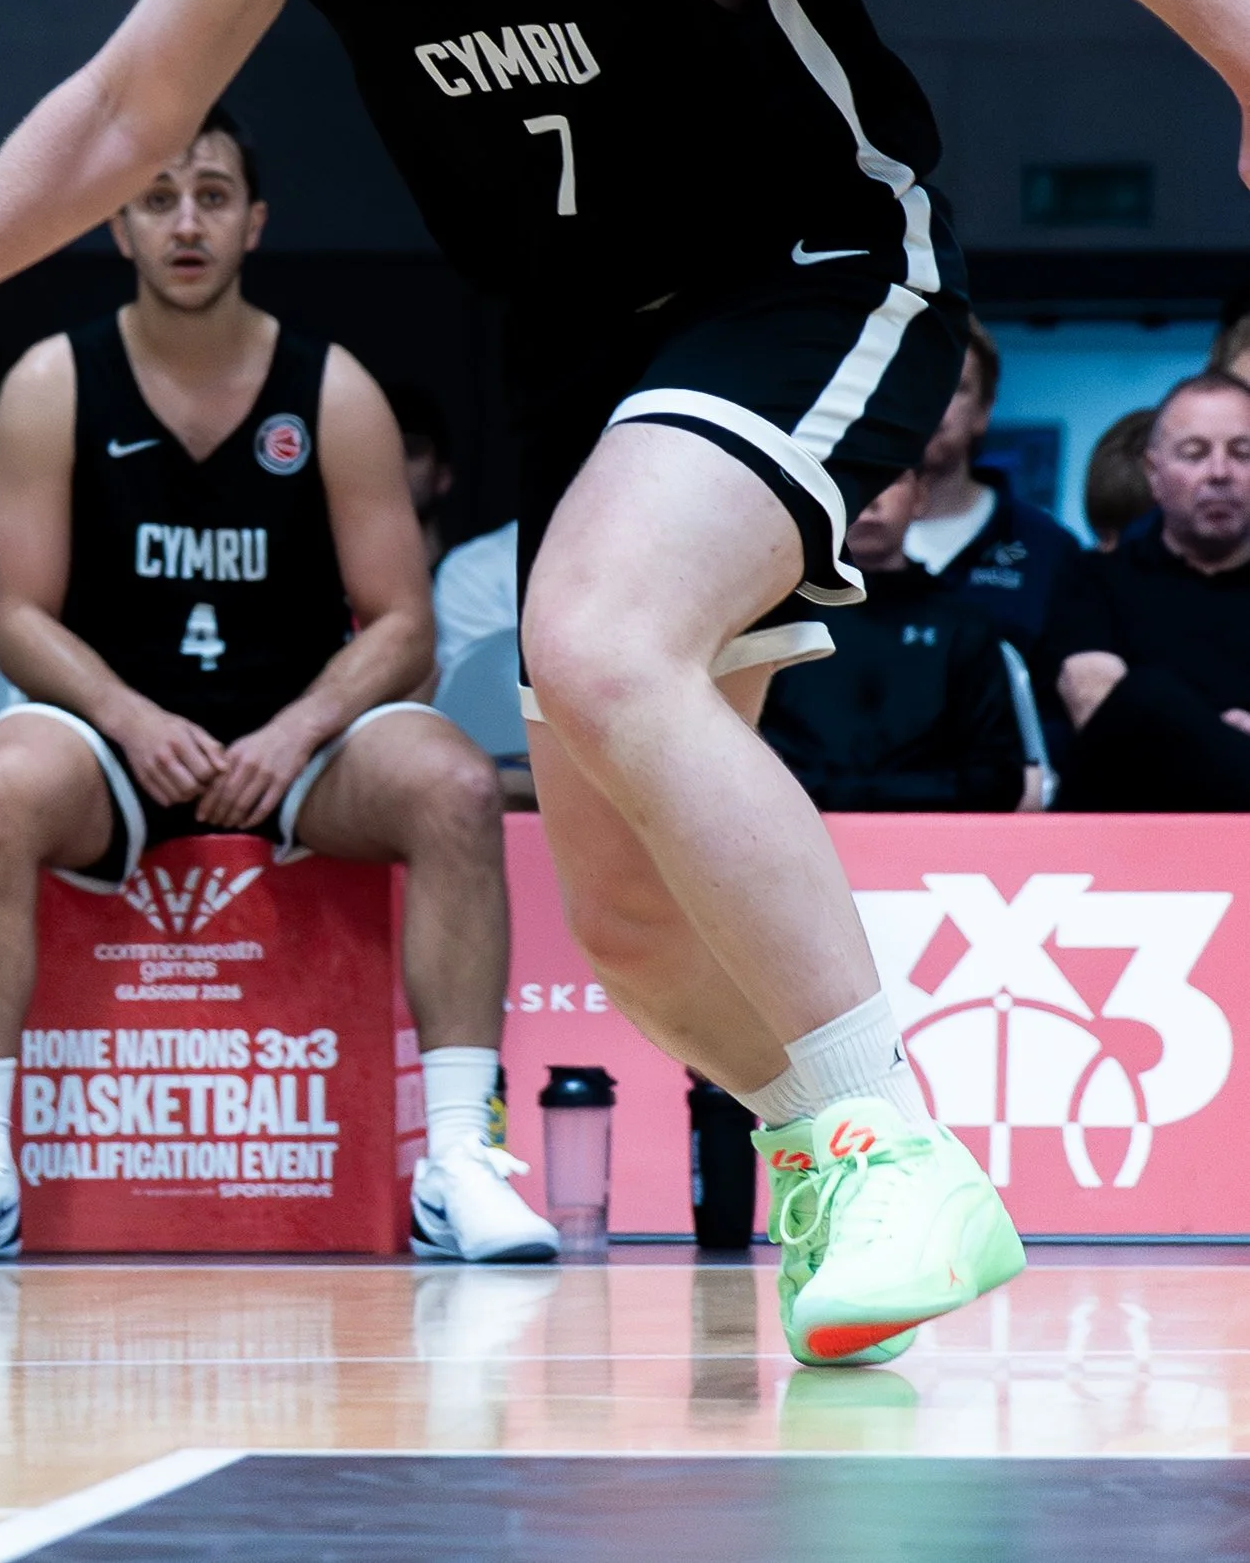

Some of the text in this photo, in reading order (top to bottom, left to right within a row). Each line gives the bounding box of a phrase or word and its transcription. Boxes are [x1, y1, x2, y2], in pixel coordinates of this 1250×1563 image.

[414, 22, 601, 97] CYMRU
[522, 115, 578, 216] 7
[136, 522, 268, 581] CYMRU
[180, 602, 227, 671] 4
[21, 1028, 338, 1070] HOME NATIONS 3x3
[21, 1074, 340, 1136] BASKETBALL
[20, 1142, 339, 1187] QUALIFICATION EVENT
